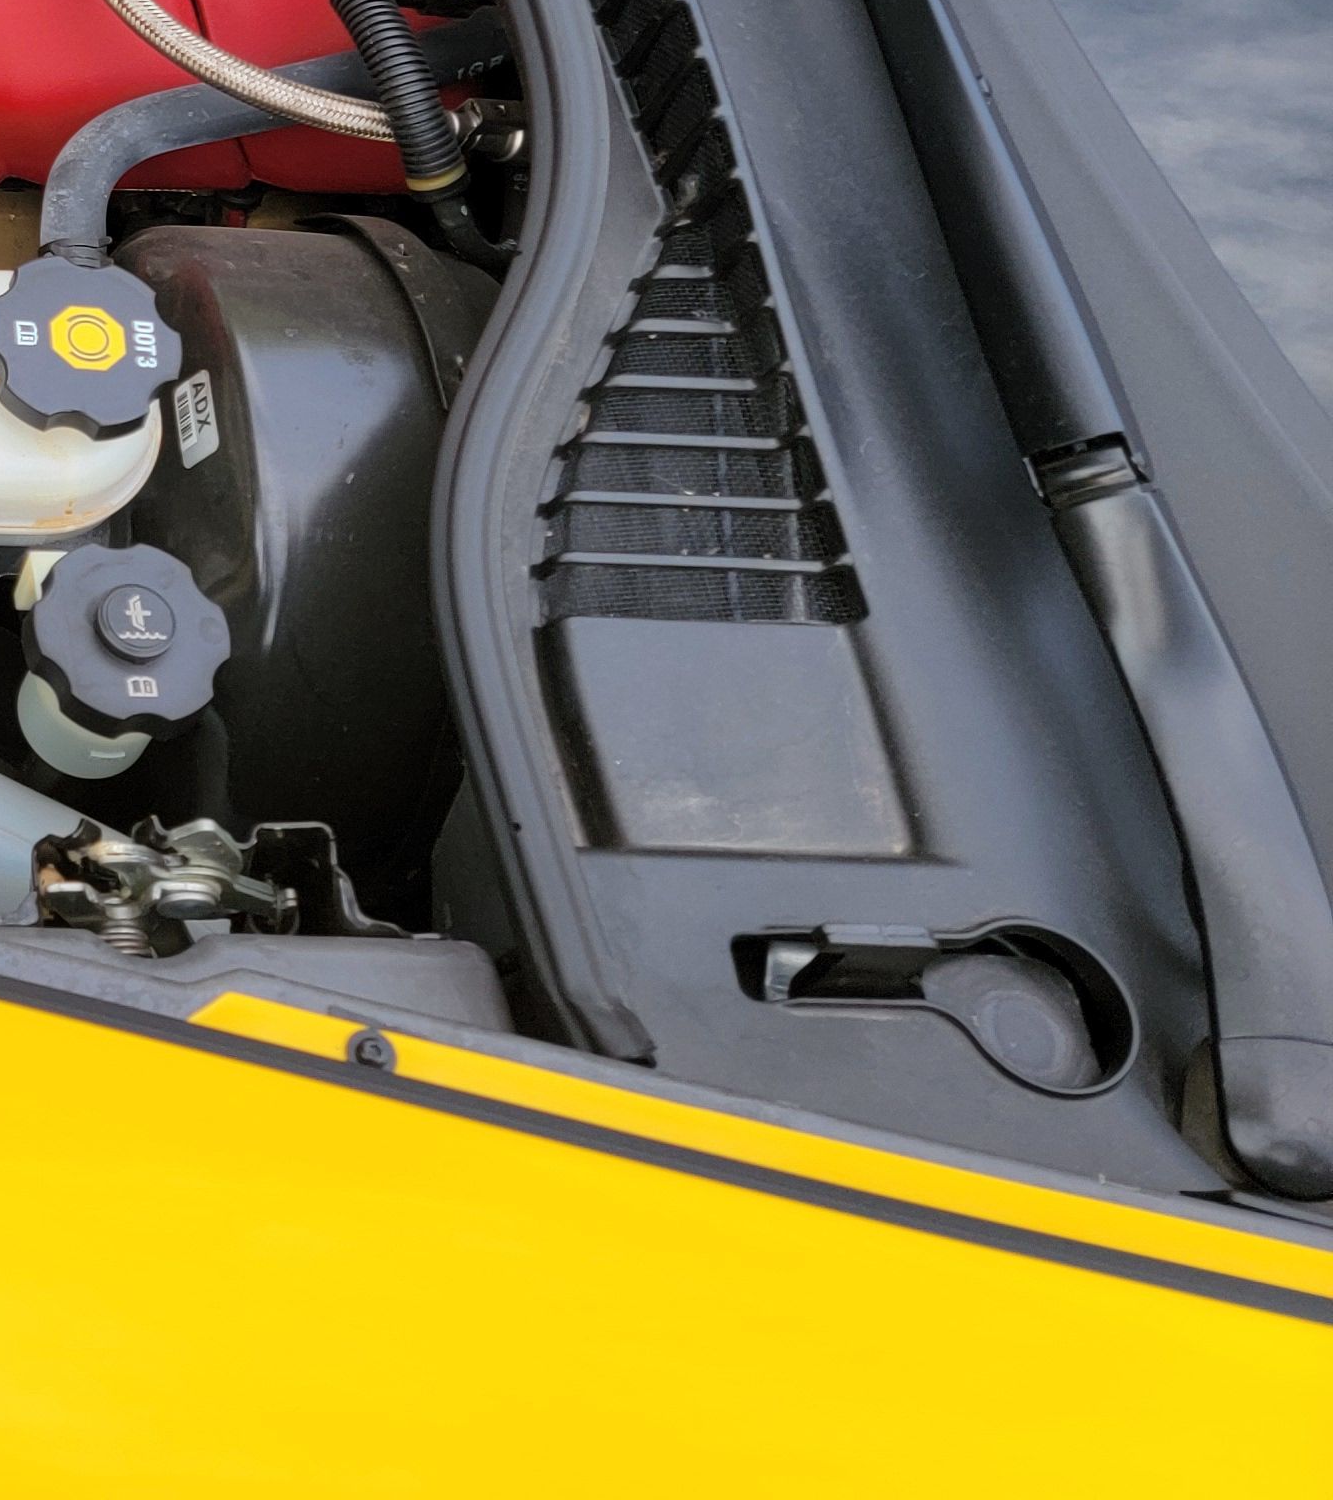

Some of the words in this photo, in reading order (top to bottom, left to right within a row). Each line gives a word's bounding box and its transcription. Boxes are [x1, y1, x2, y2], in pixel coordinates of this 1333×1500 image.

[133, 320, 157, 356] DOT
[136, 355, 158, 369] 3
[192, 382, 211, 434] ADX
